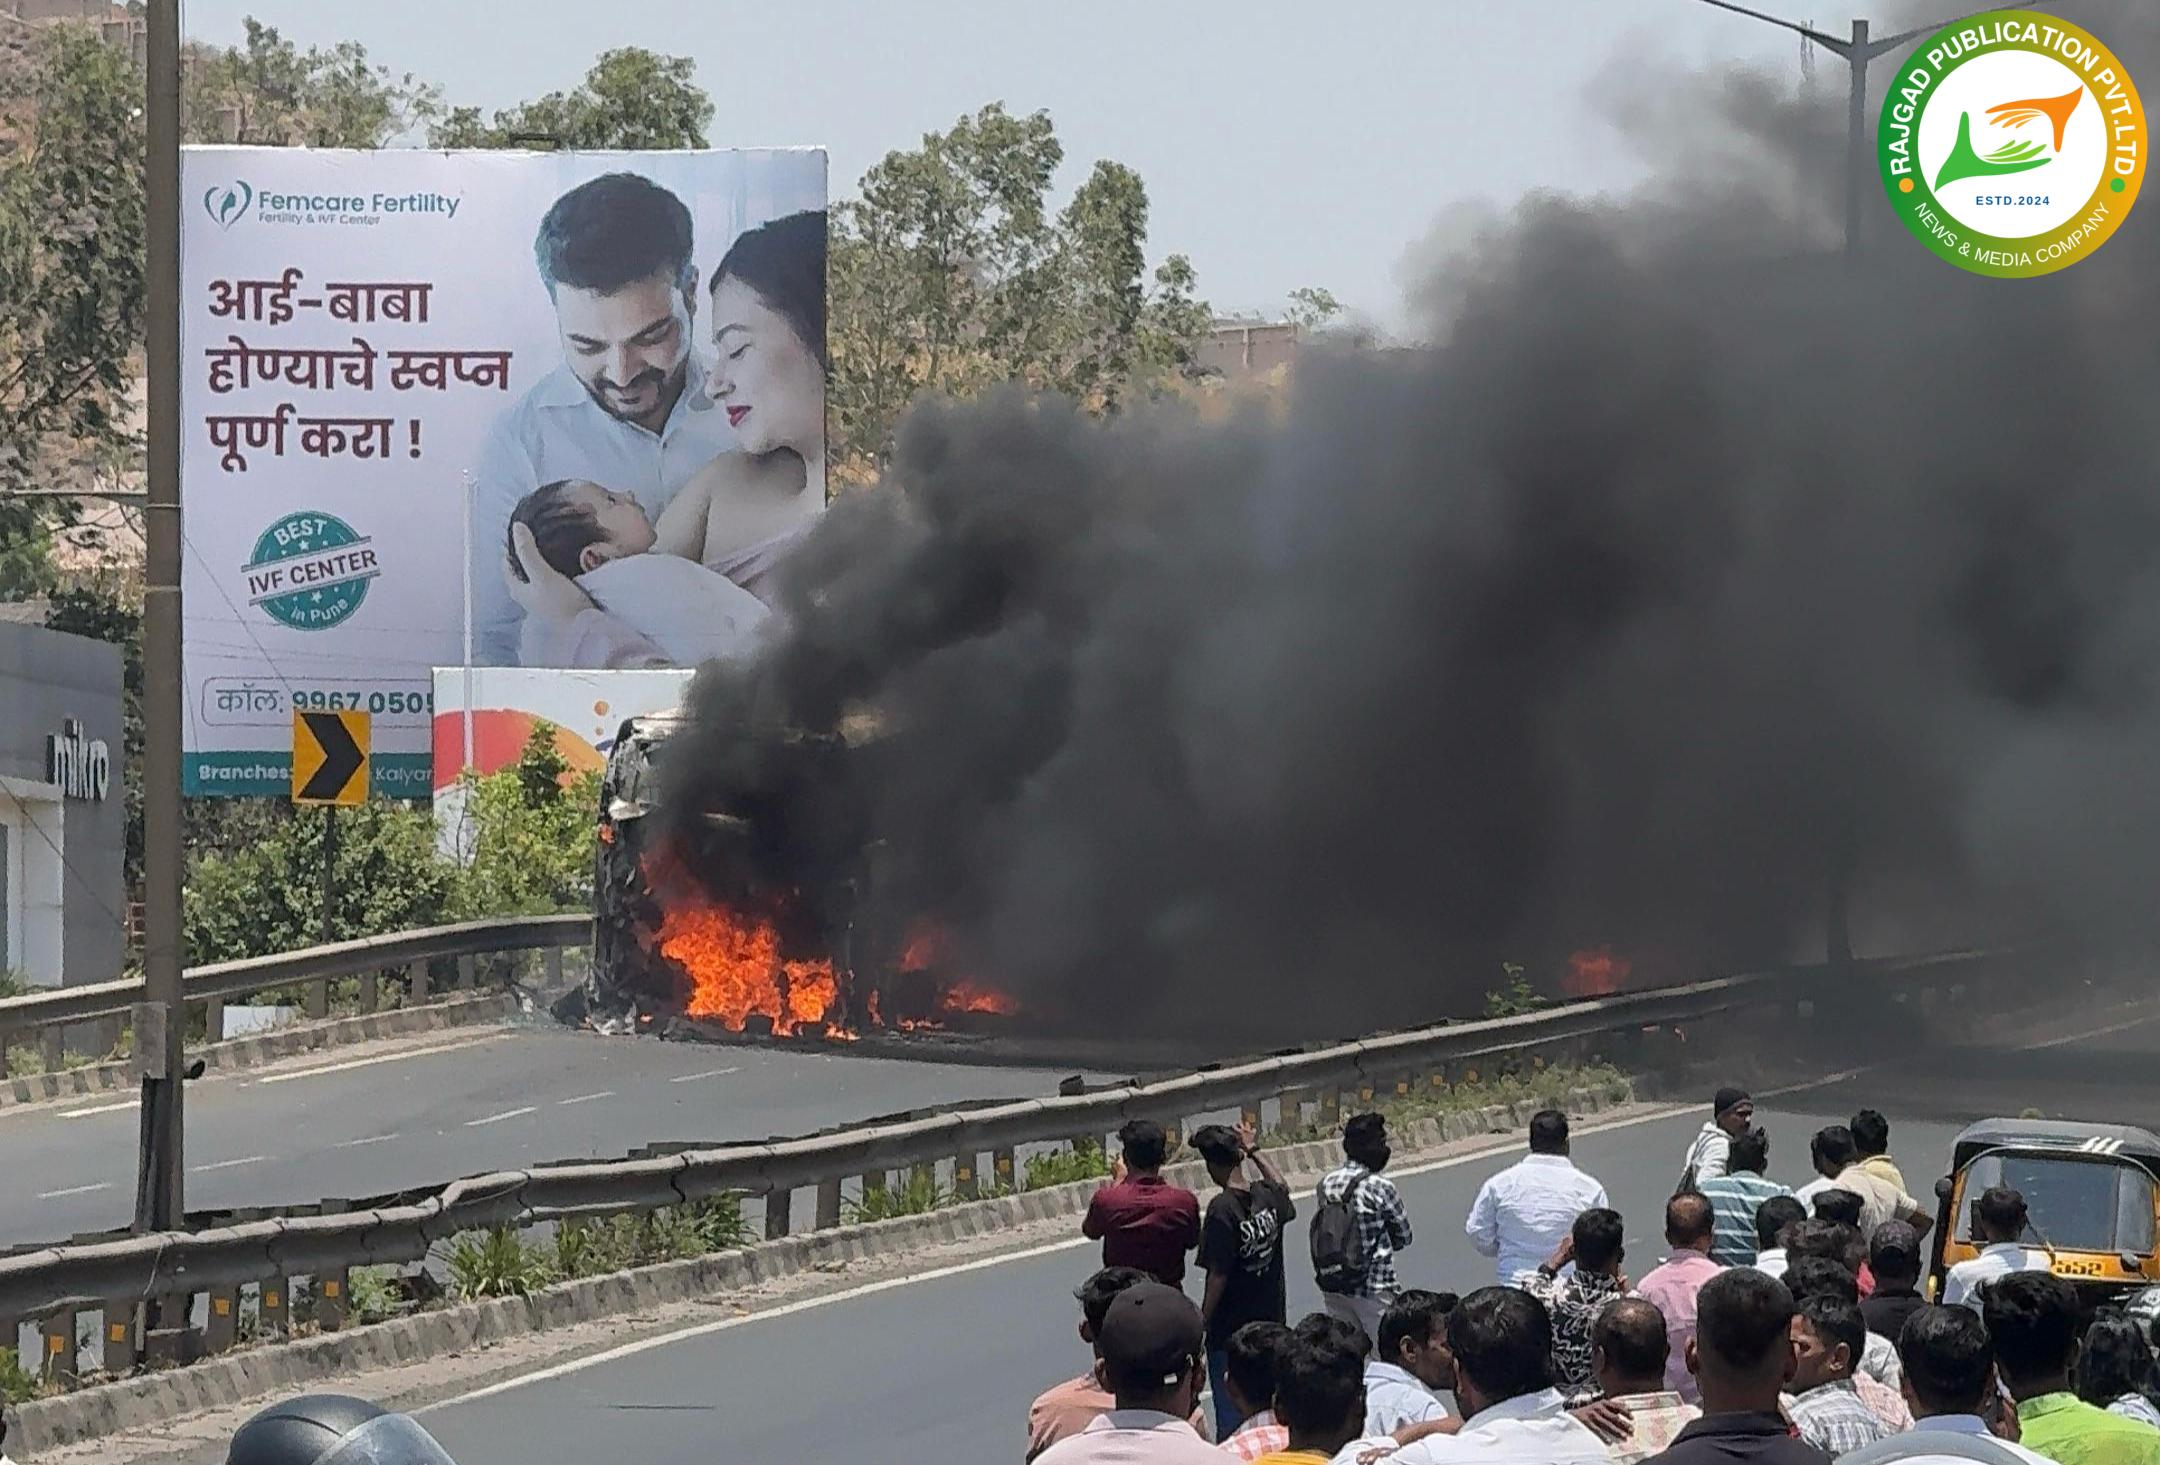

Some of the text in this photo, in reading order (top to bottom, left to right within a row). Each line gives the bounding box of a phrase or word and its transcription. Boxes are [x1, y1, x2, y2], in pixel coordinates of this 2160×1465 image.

[258, 191, 460, 219] Femcare Fertility
[258, 212, 380, 226] Fertility & IVF Center
[208, 268, 433, 325] आई-बाबा
[205, 335, 513, 393] होण्याचे स्वप्न
[205, 403, 296, 472] पूर्ण
[298, 418, 394, 458] करा
[274, 518, 327, 546] BEST
[248, 549, 377, 595] IVF CENTER
[291, 599, 349, 622] in Pune
